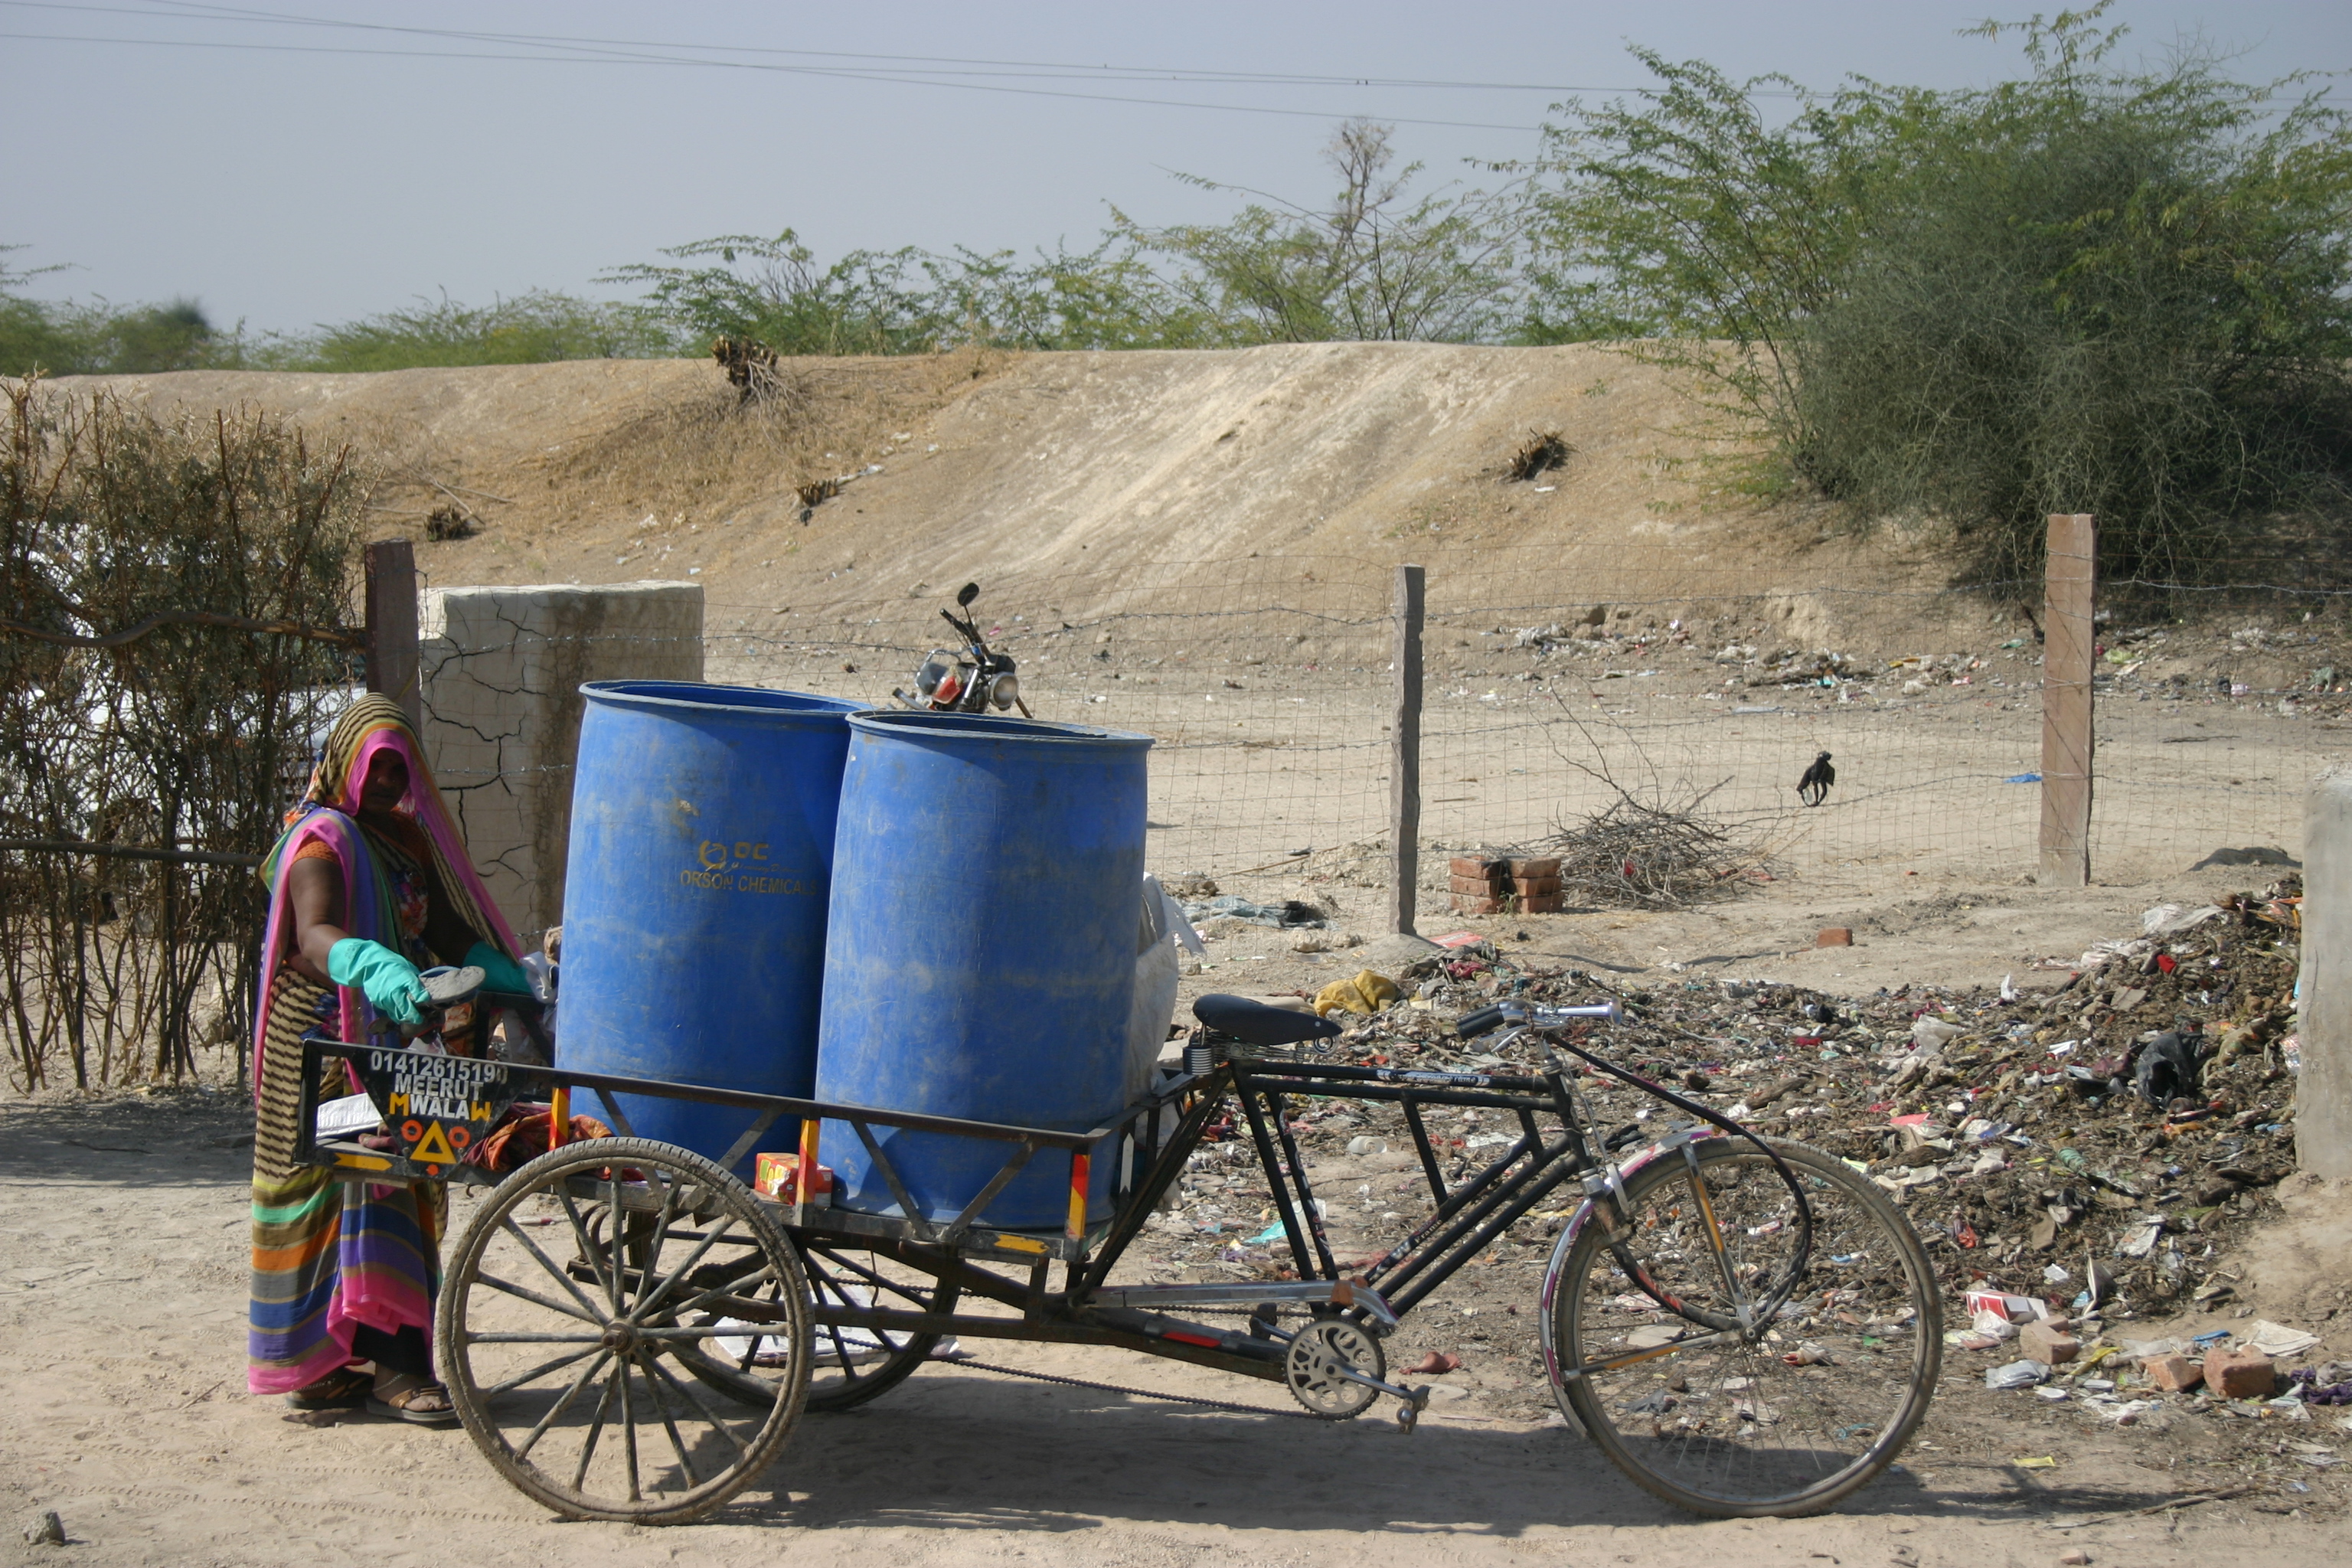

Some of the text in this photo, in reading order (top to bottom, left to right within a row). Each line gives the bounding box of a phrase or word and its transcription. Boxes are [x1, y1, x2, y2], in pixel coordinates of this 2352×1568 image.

[681, 869, 817, 895] ORSON CHEMICALS
[371, 1050, 508, 1084] 01412615190
[394, 1073, 484, 1101] MEERUT
